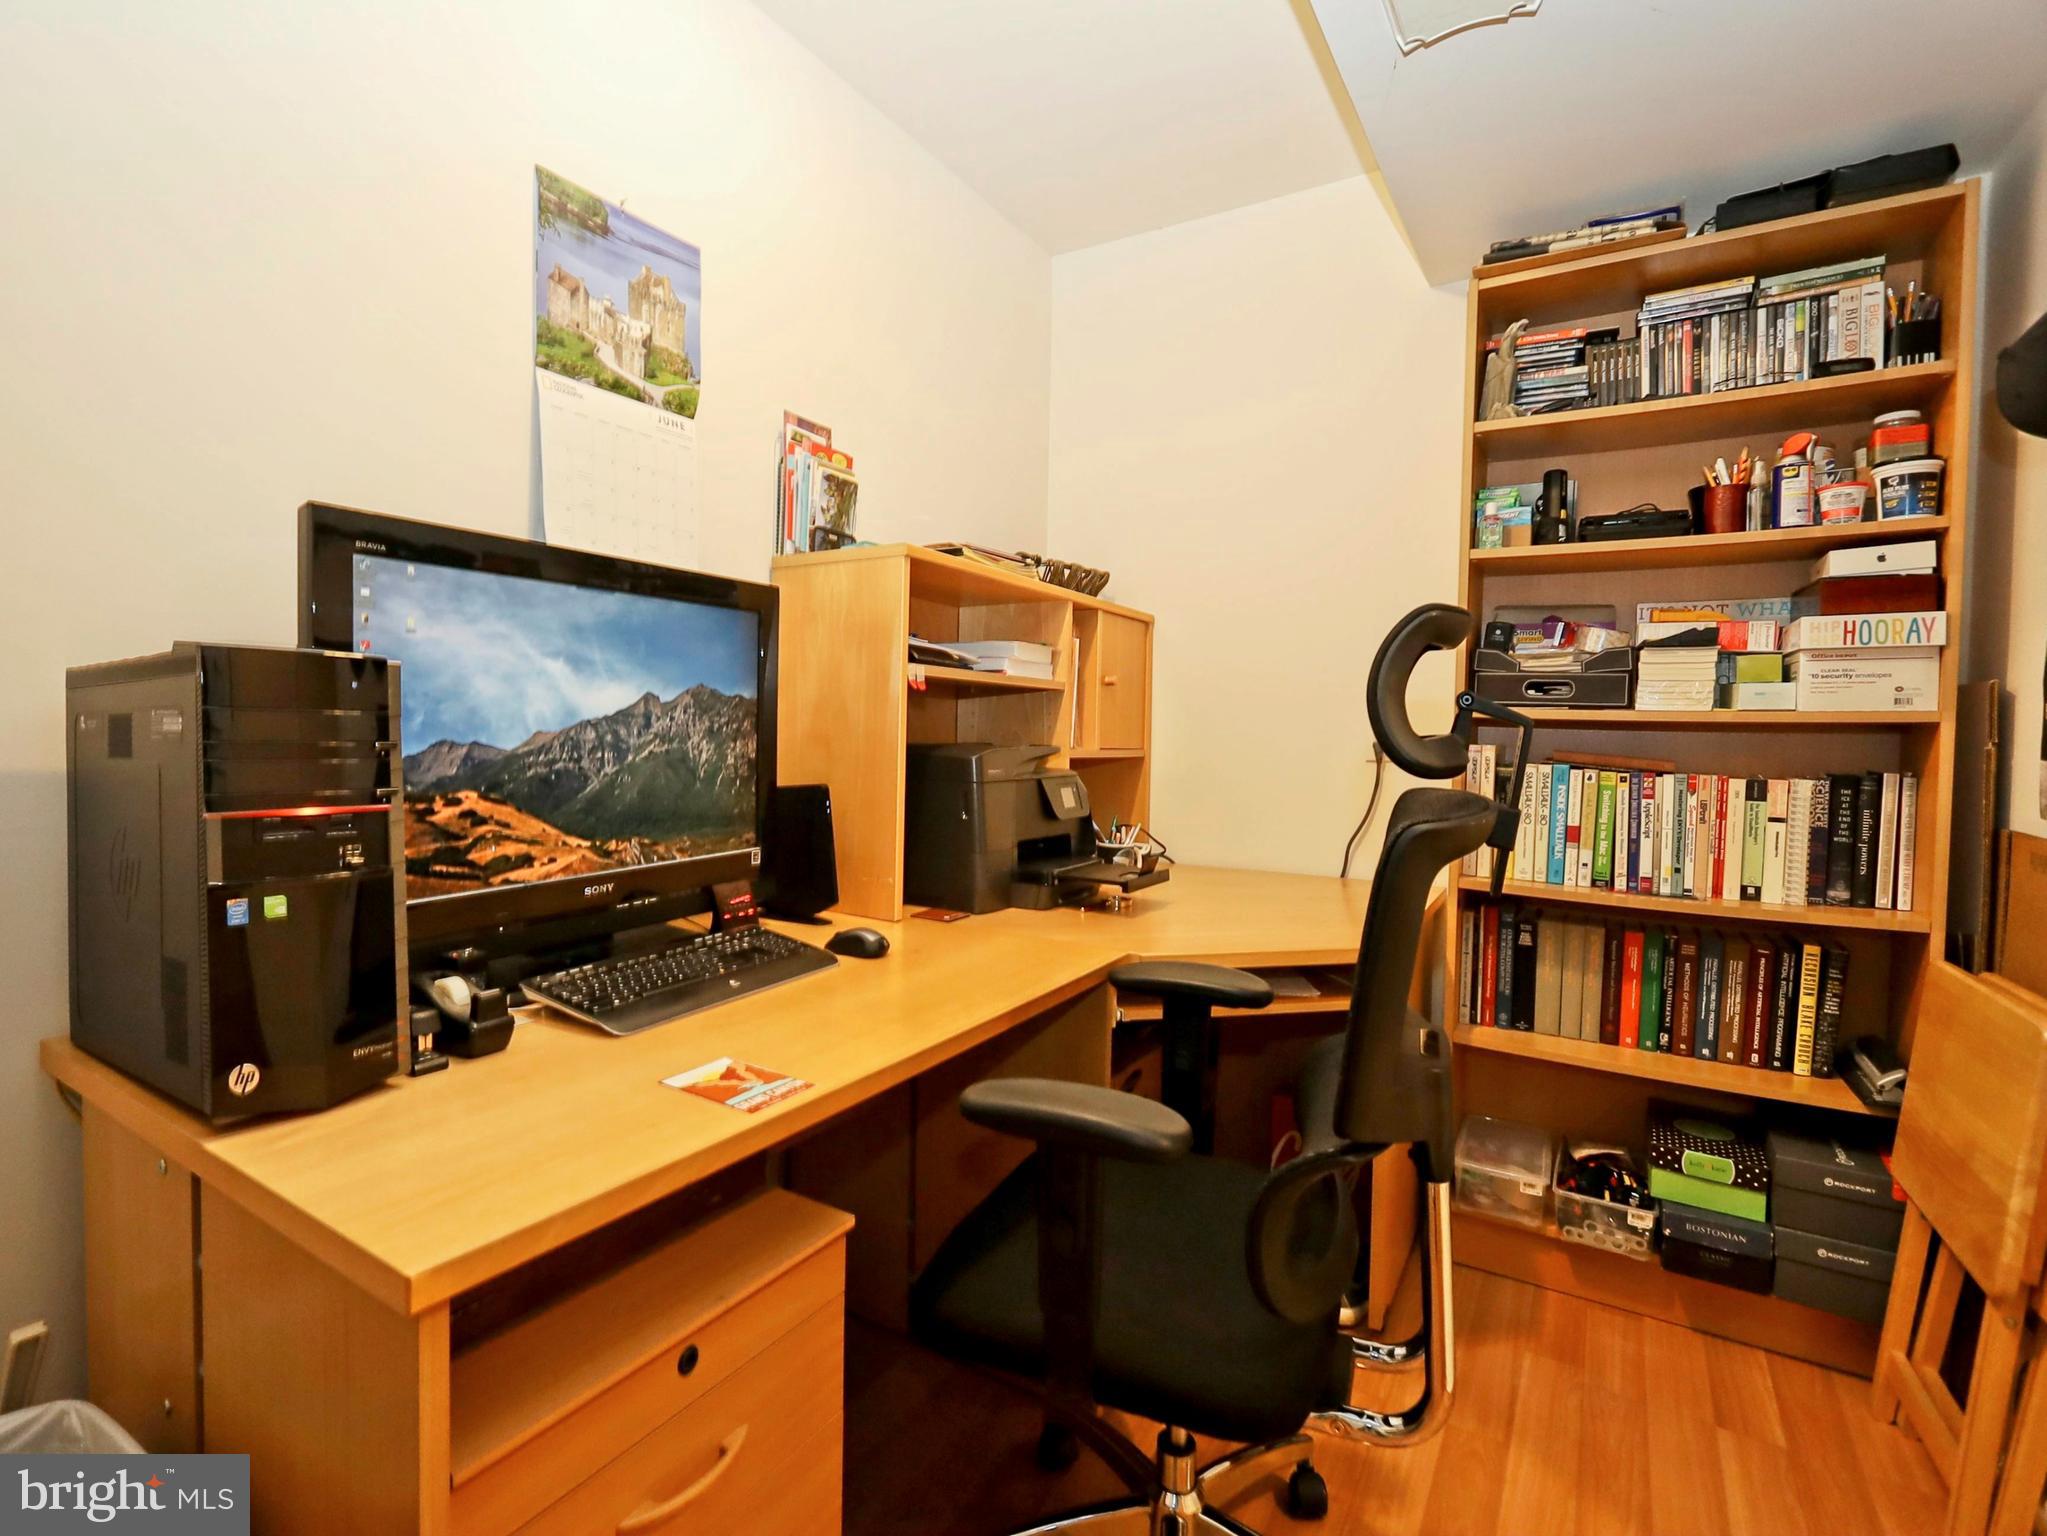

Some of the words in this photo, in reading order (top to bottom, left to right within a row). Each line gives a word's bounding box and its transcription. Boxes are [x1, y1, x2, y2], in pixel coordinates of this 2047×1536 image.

[1845, 307, 1858, 331] BIG
[1843, 333, 1858, 359] LOV
[657, 415, 686, 432] JUNE
[355, 540, 386, 551] BRAVIA
[1737, 602, 1793, 617] WHA
[1809, 622, 1841, 633] HIP
[1843, 616, 1937, 646] HOORAY
[1820, 673, 1854, 681] security
[1854, 672, 1893, 680] envelopes
[1557, 784, 1567, 811] INSIDE
[1599, 790, 1612, 823] Switching
[1676, 789, 1684, 819] Mastering
[1815, 780, 1825, 828] SCIENCE
[1642, 801, 1652, 839] AppleScript
[1861, 809, 1874, 842] infinite
[1554, 811, 1566, 860] SMALLTALK
[1599, 840, 1609, 856] Mac
[1858, 843, 1869, 876] powers
[584, 883, 615, 896] SONY
[1781, 952, 1790, 979] ARTIFICIAL
[1802, 951, 1819, 997] RECURSION
[1683, 992, 1690, 1001] OF
[1758, 983, 1764, 991] OF
[1777, 980, 1787, 1017] INTELLIGENCE
[1755, 991, 1763, 1016] ARTIFICIAL
[1799, 1004, 1815, 1029] BLAKE
[1707, 1011, 1715, 1041] PROCESSING
[1732, 1014, 1740, 1043] PROCESSING
[1753, 1016, 1761, 1050] INTELLIGENCE
[1774, 1017, 1784, 1058] PROGRAMMING
[1797, 1033, 1812, 1065] CROUCH
[231, 1063, 258, 1096] hp
[1834, 1181, 1876, 1195] ROCKPORT
[1685, 1222, 1747, 1244] BOSTONIAN
[1827, 1251, 1870, 1266] ROCKPORT
